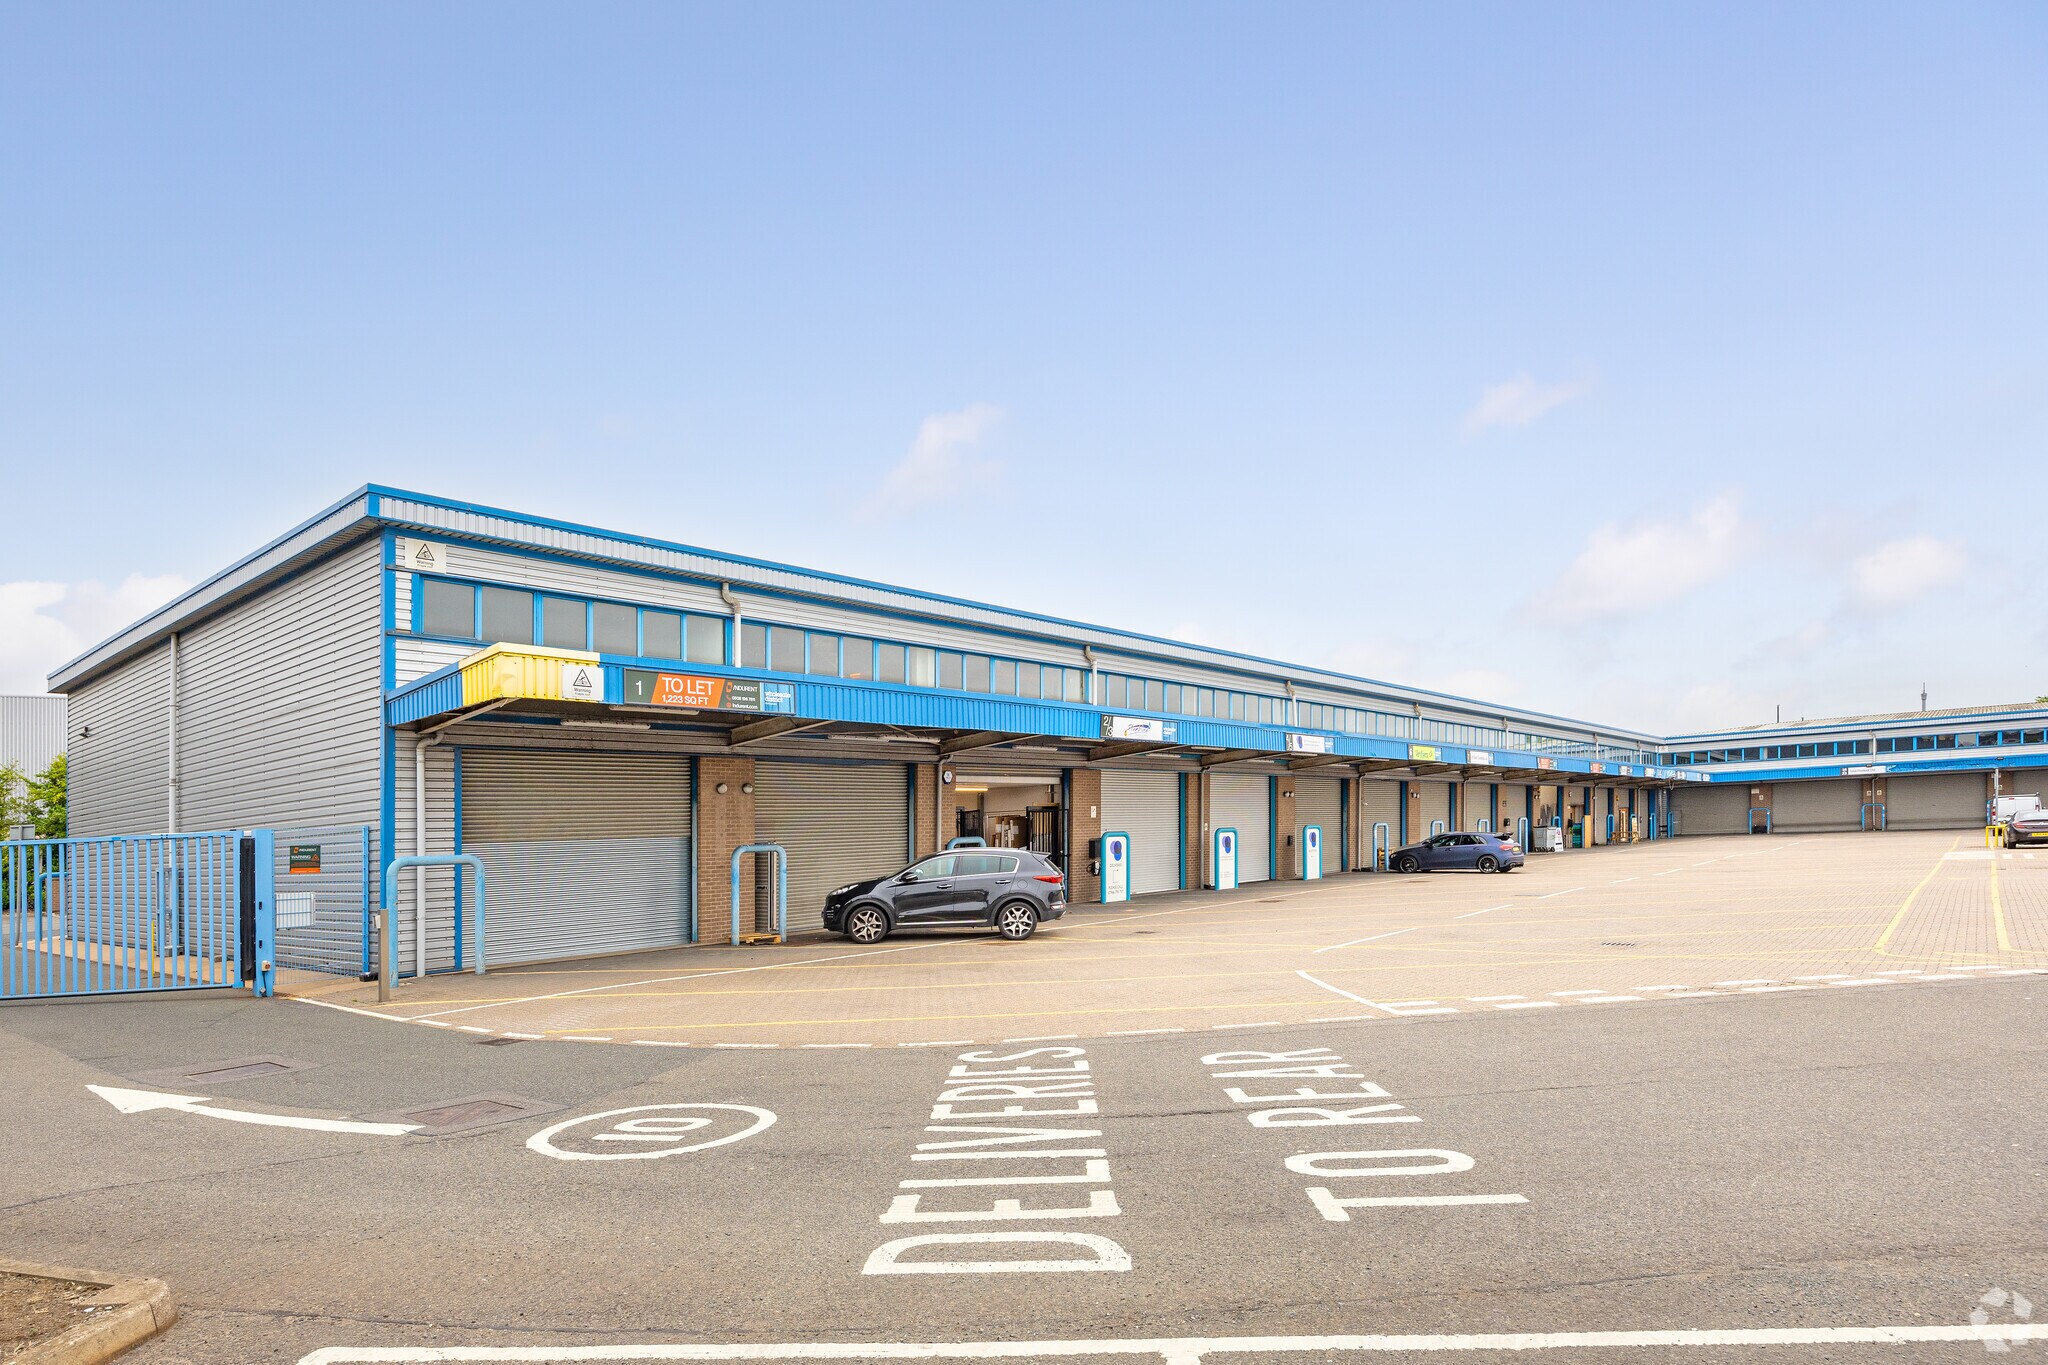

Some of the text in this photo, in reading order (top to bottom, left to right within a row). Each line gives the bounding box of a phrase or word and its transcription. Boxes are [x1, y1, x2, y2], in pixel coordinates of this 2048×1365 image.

[635, 680, 642, 696] 1
[661, 677, 715, 696] TO LET
[661, 694, 709, 705] 1,223 SQ FT
[592, 1117, 714, 1142] 10
[1200, 1047, 1530, 1222] TO REAR
[860, 1046, 1132, 1275] DELIVERIES
